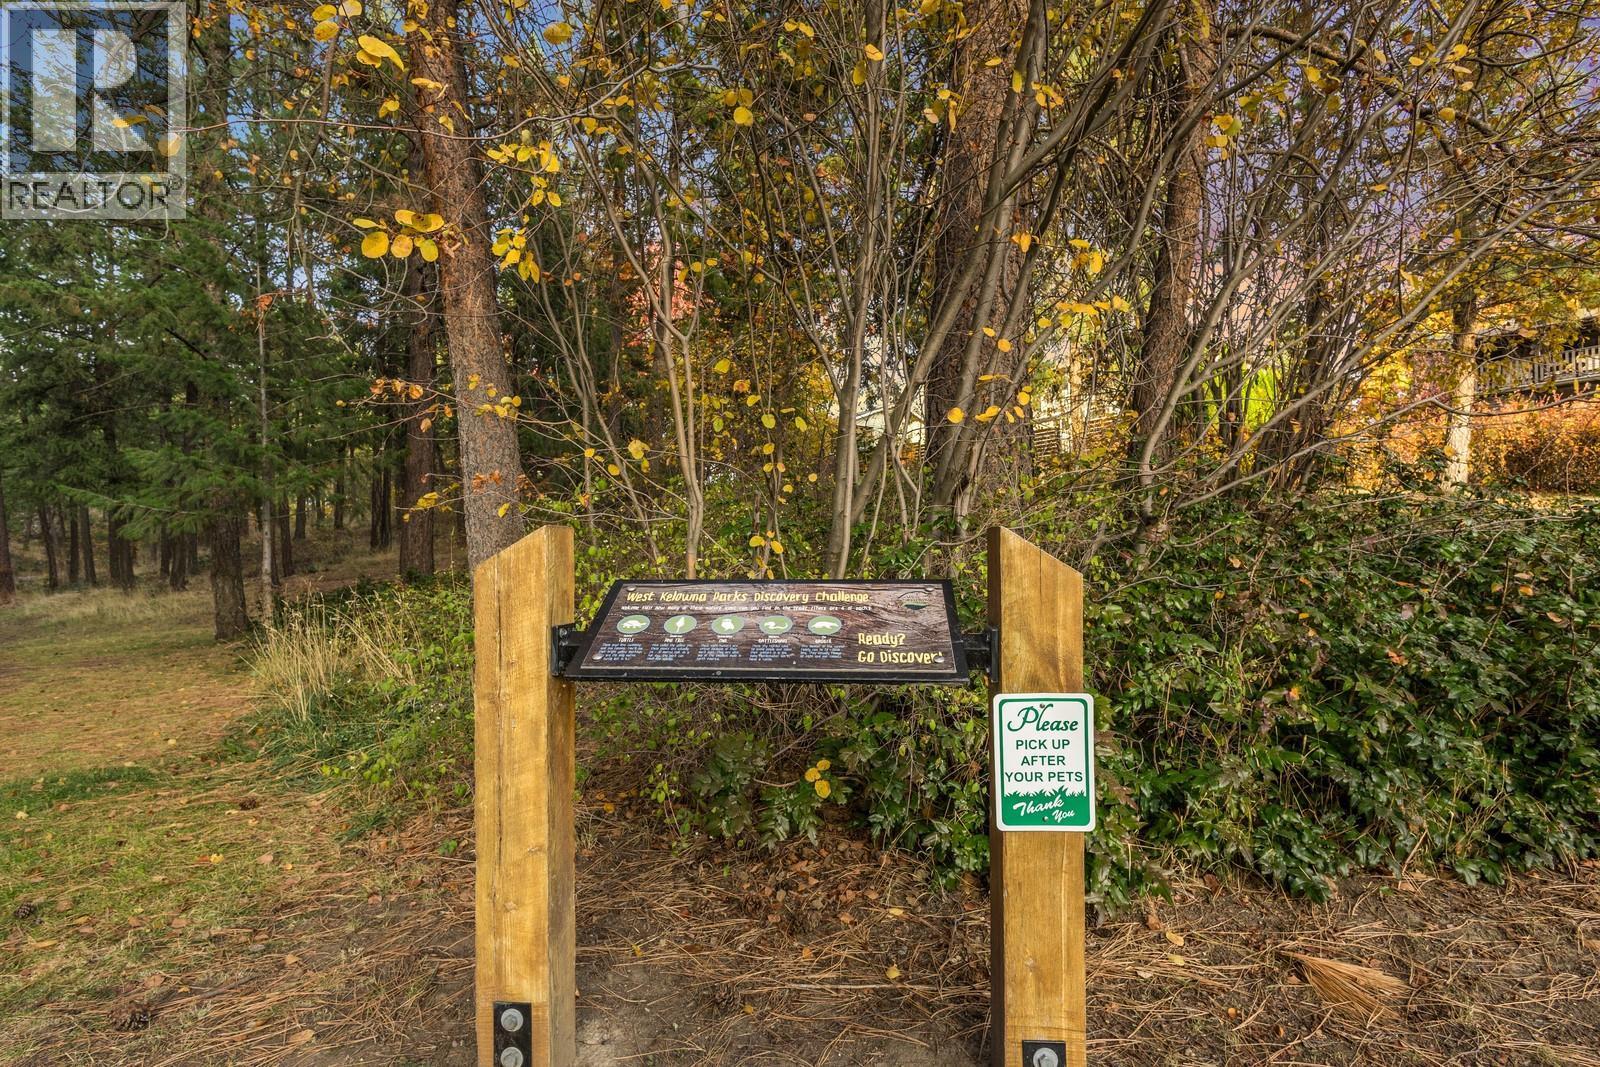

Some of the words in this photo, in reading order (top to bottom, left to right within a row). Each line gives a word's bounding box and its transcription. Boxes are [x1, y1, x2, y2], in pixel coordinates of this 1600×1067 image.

[627, 591, 655, 602] West
[660, 590, 707, 602] Kelowna
[713, 590, 748, 602] Parks
[754, 591, 809, 603] Discovery
[815, 590, 869, 603] Challenge
[858, 632, 906, 648] Ready?
[857, 650, 875, 663] Go
[1007, 703, 1079, 732] Please
[1016, 739, 1047, 750] PICK
[1052, 739, 1070, 750] UP
[1021, 755, 1066, 766] AFTER
[1005, 771, 1043, 782] YOUR
[1048, 771, 1083, 782] PETS
[1013, 794, 1064, 816] Thank
[1052, 809, 1075, 823] You
